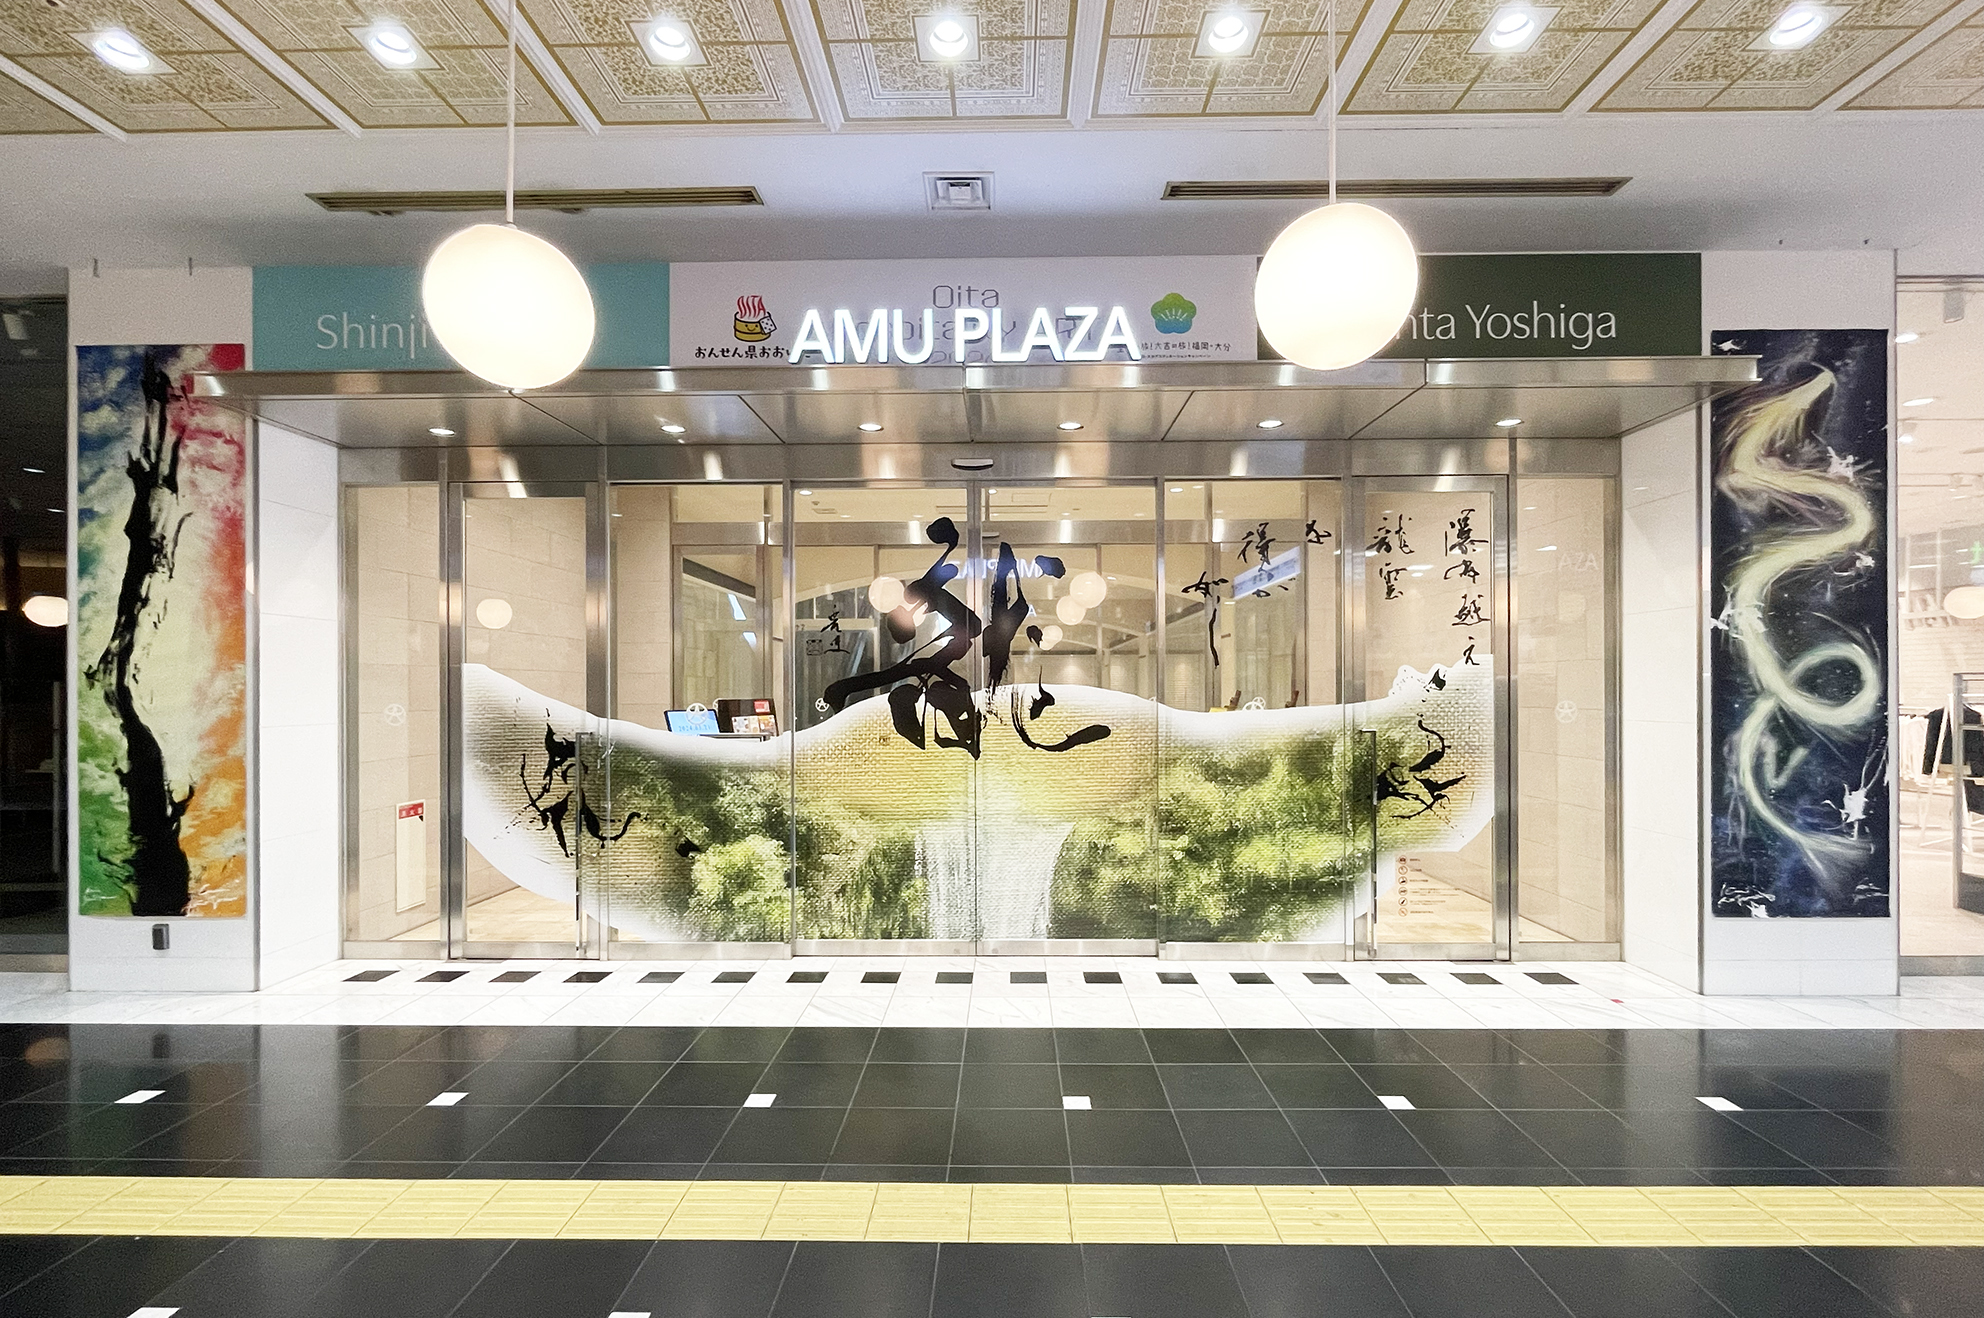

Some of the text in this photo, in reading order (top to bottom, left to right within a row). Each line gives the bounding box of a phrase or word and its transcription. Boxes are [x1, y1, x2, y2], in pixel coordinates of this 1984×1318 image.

[932, 285, 999, 309] Oita
[788, 308, 934, 364] AMU
[955, 306, 1143, 363] PLAZA
[1396, 300, 1616, 350] nta Yoshiga
[695, 346, 811, 359] おんせん県おお
